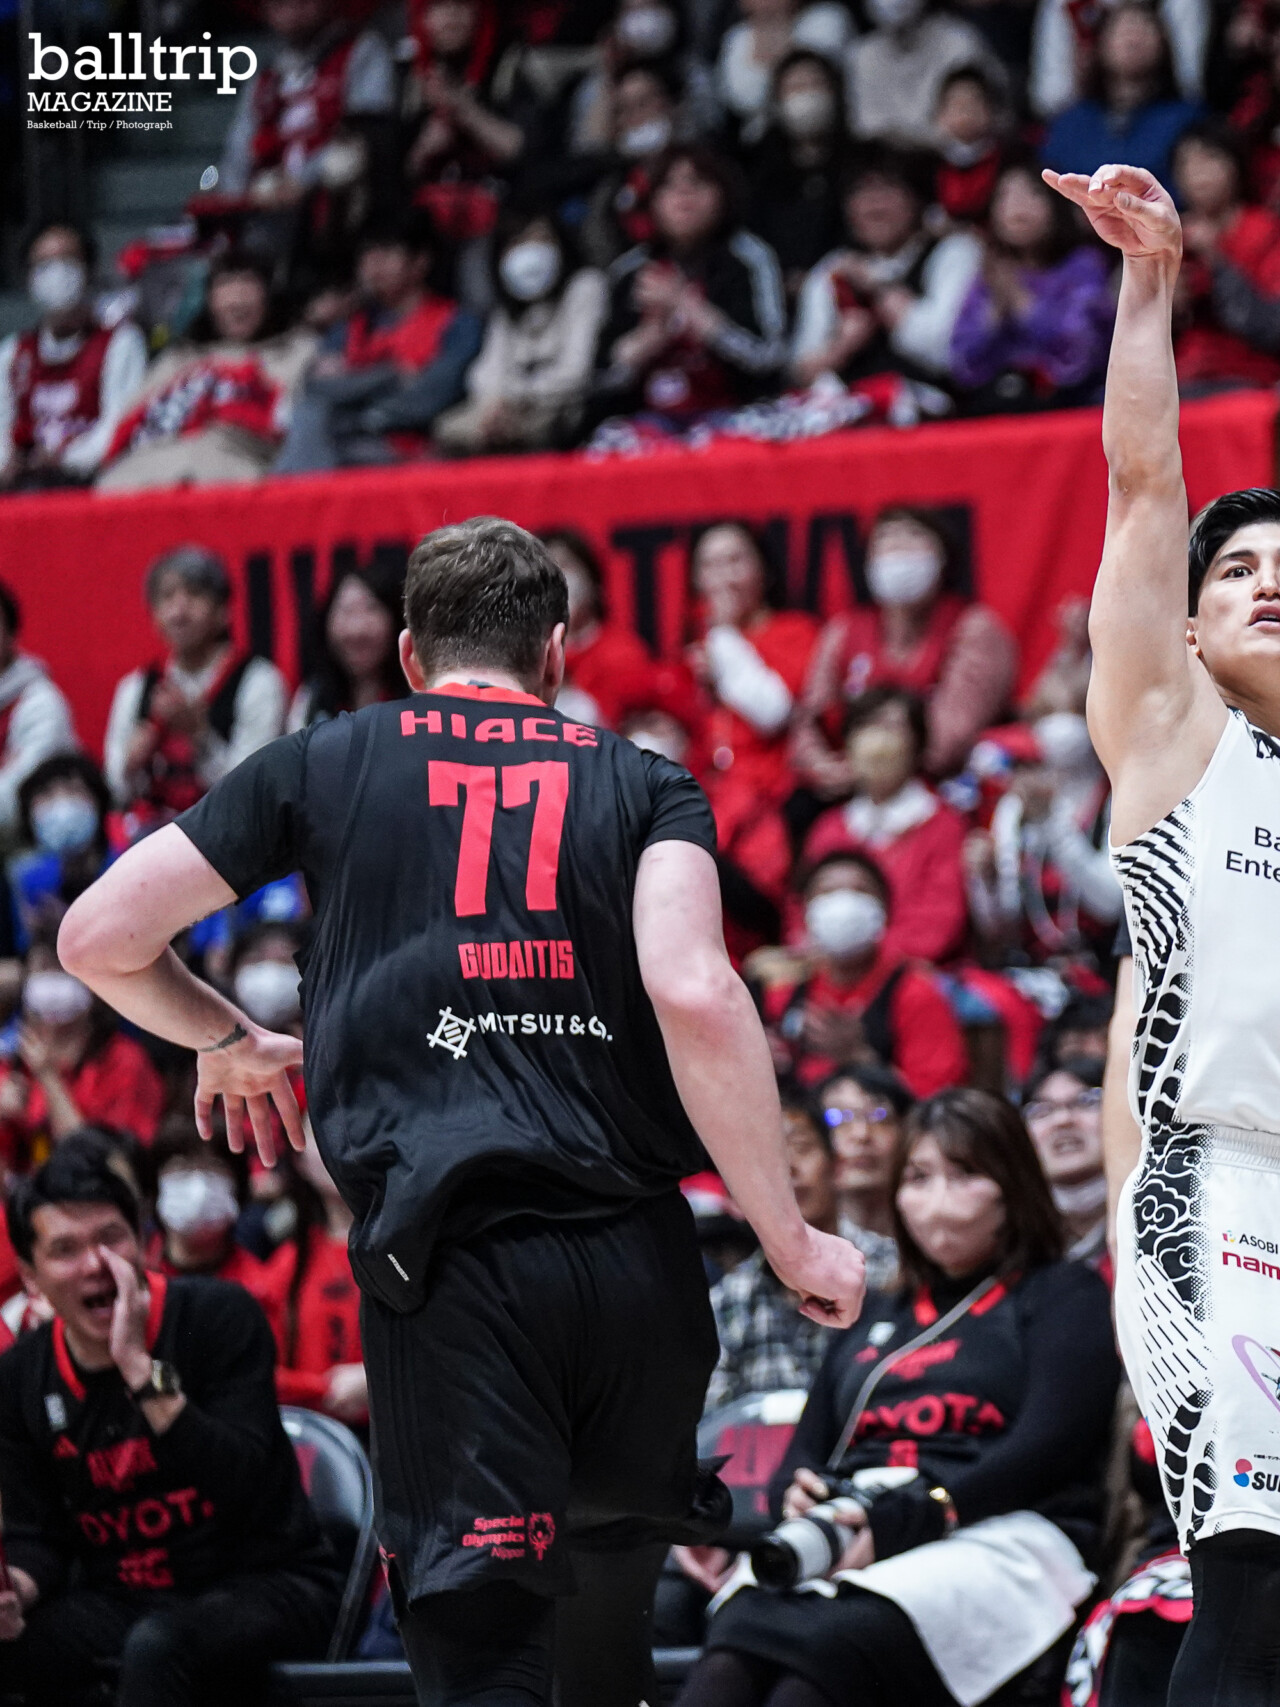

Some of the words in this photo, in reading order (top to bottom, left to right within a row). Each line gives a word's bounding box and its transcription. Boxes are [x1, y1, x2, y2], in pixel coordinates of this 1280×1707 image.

[400, 710, 599, 748] HIACE
[427, 759, 570, 918] 77
[457, 939, 576, 980] GUDAITIS
[1238, 1232, 1279, 1255] ASOBI
[473, 1515, 525, 1532] Special
[462, 1530, 525, 1548] Olympics
